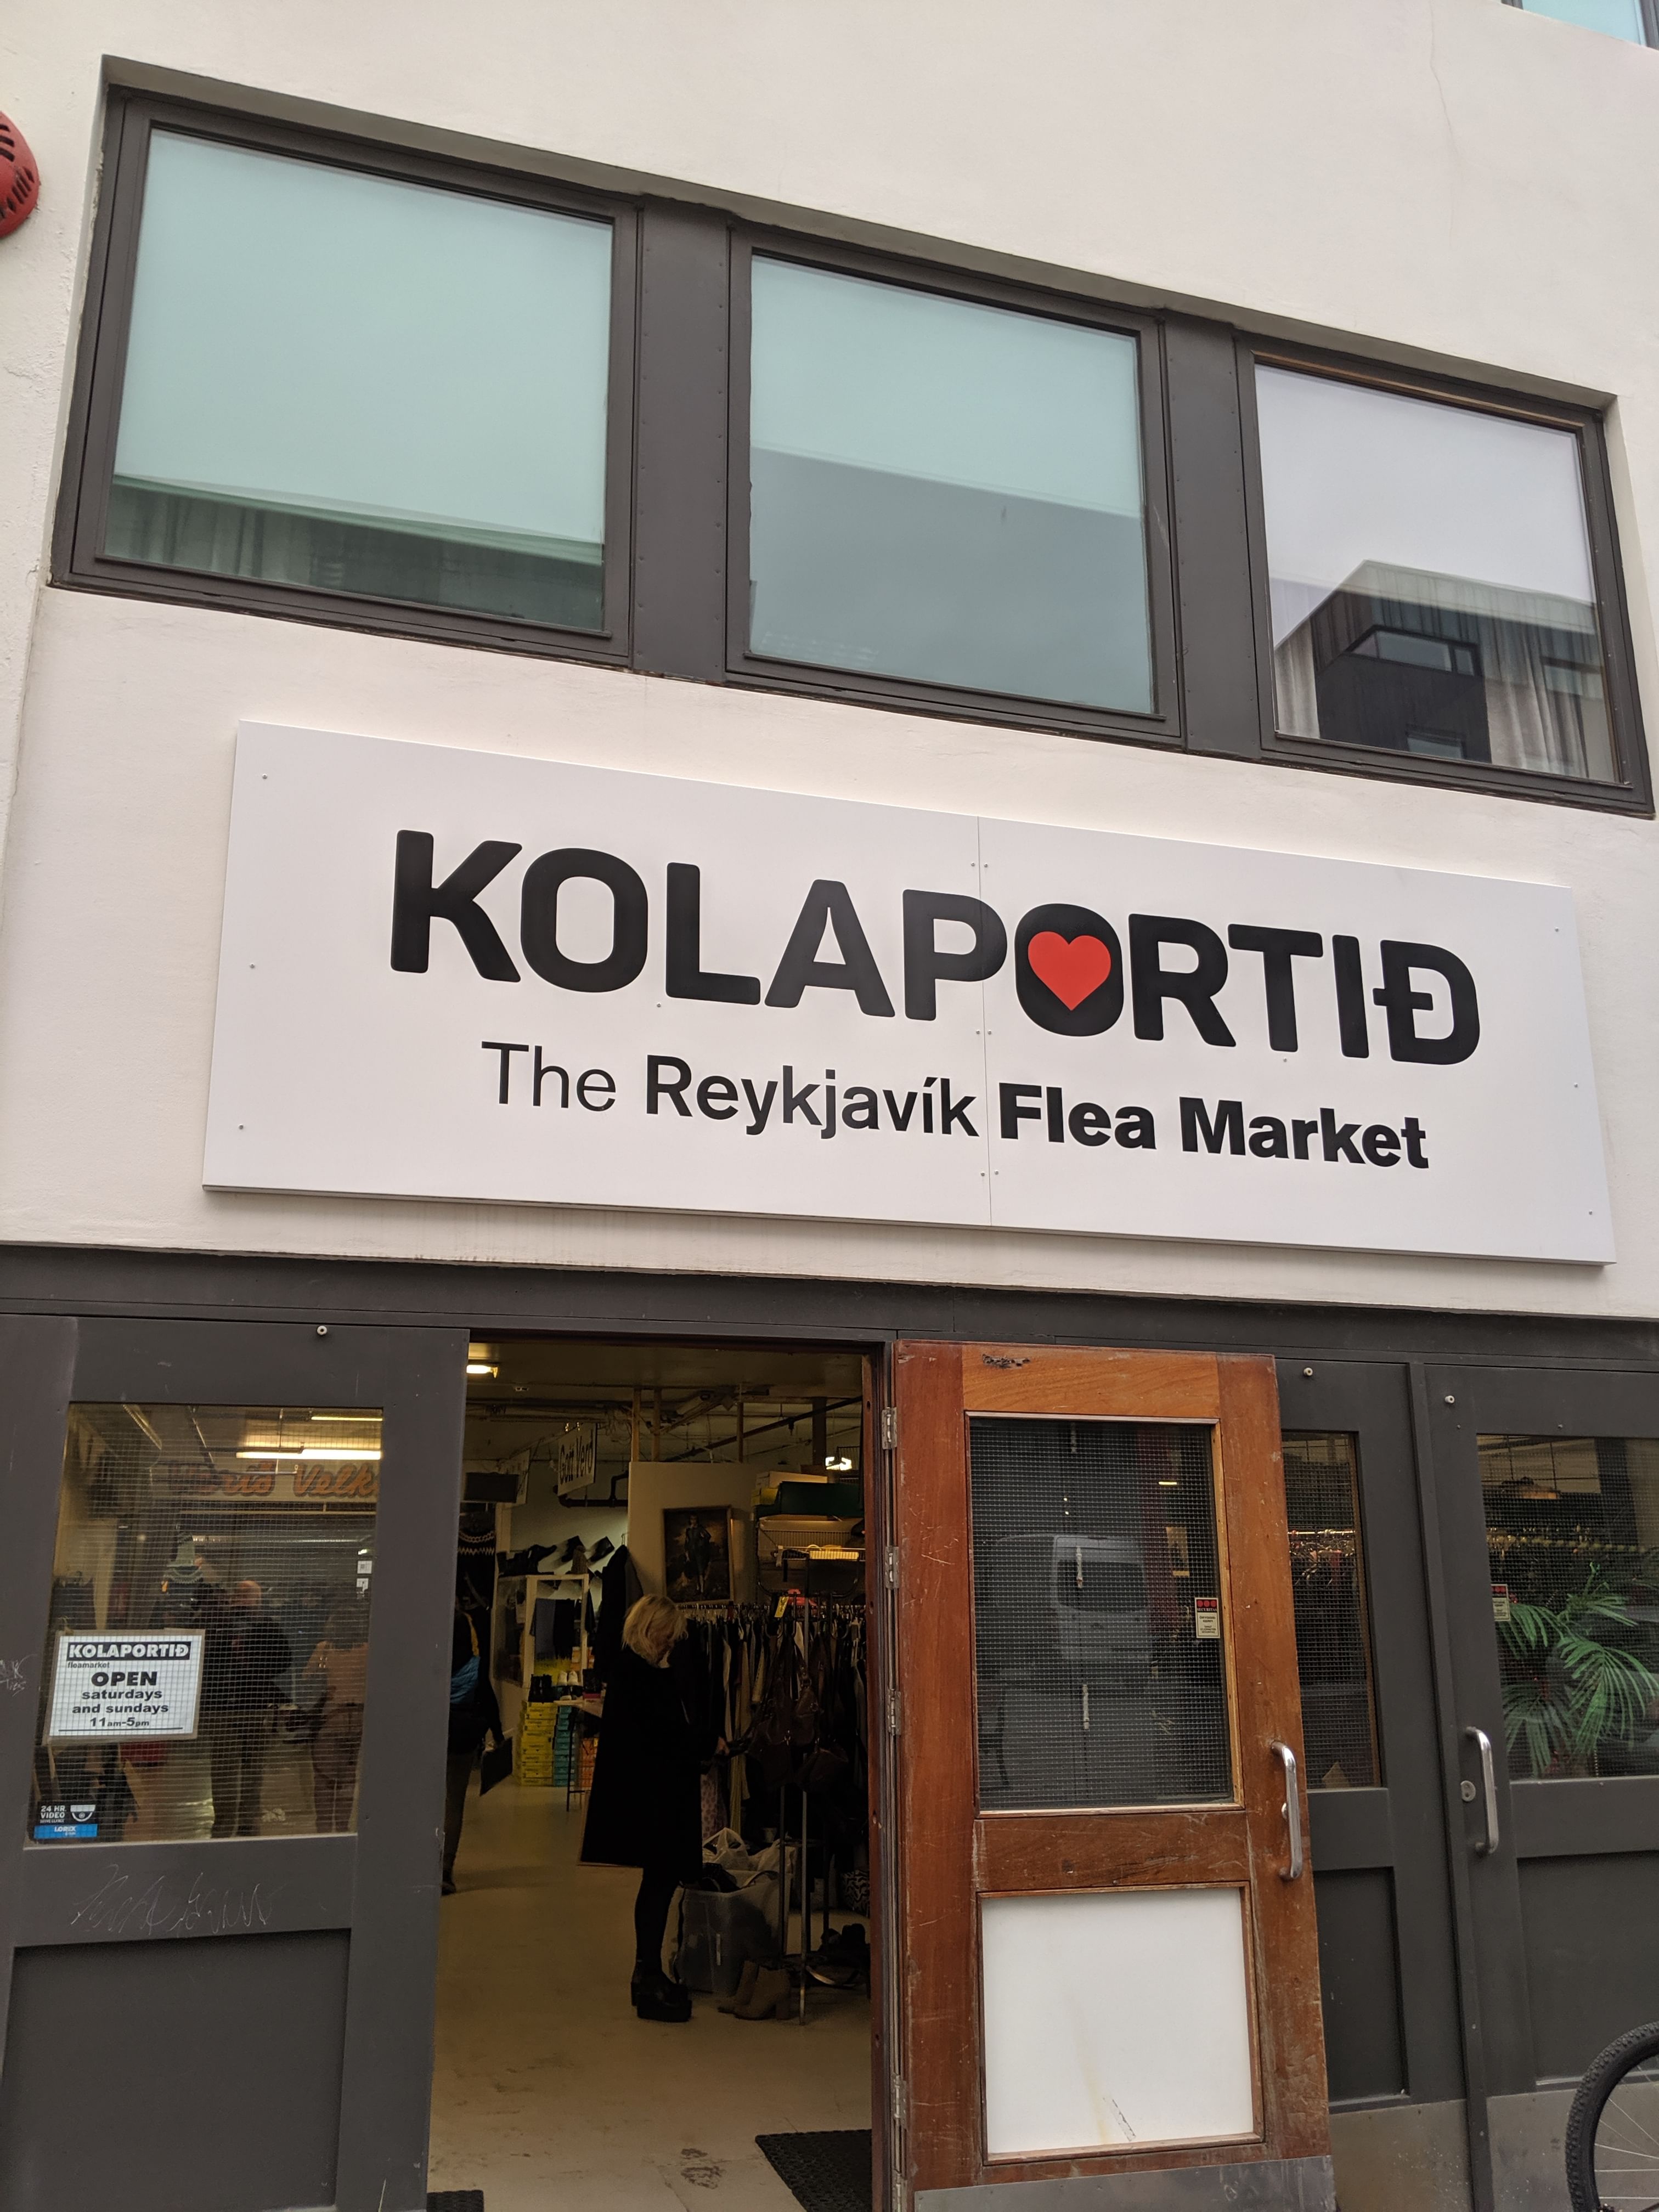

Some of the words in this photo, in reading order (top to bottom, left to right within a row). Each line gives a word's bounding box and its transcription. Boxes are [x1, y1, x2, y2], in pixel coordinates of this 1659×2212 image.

[390, 829, 1481, 1066] KOLAPORTIÐ
[481, 1041, 617, 1112] The
[646, 1054, 980, 1140] Reykjavík
[998, 1082, 1157, 1150] Flea
[1178, 1096, 1430, 1170] Market
[293, 1463, 379, 1498] Velk
[91, 1671, 158, 1686] OPEN
[82, 1689, 162, 1701] saturdays
[72, 1703, 100, 1713] and
[105, 1703, 169, 1714] sundays
[89, 1717, 150, 1728] 11am-5pm
